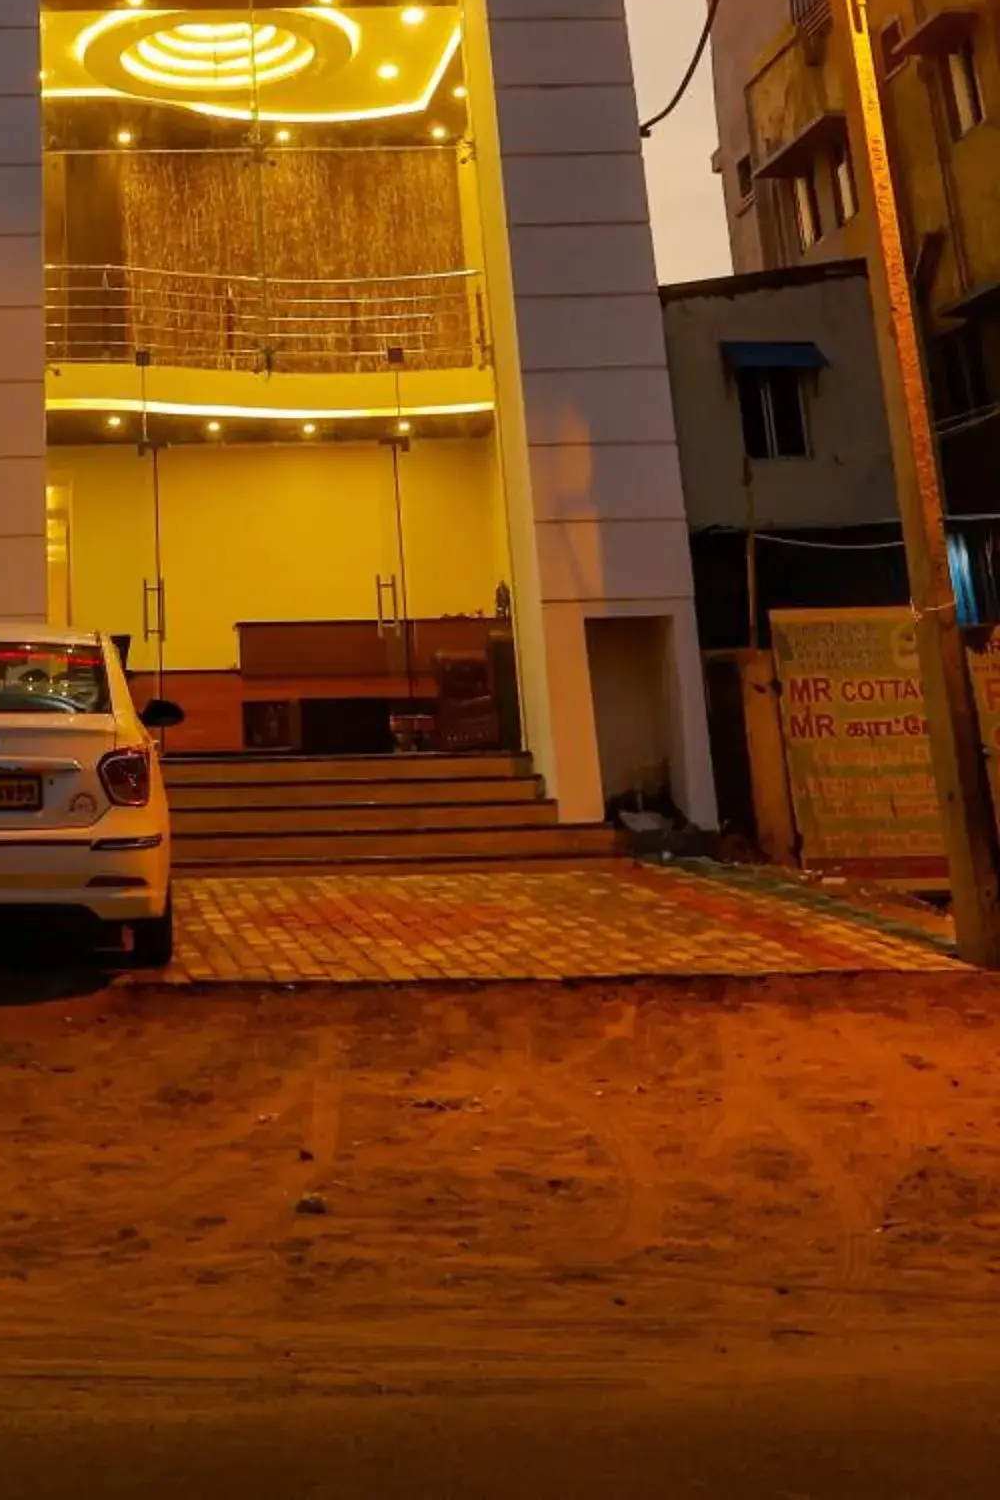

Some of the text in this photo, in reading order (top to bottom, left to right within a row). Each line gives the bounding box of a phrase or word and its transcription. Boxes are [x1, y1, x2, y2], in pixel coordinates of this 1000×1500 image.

[790, 678, 923, 702] MR COTTA
[791, 715, 835, 738] MR
